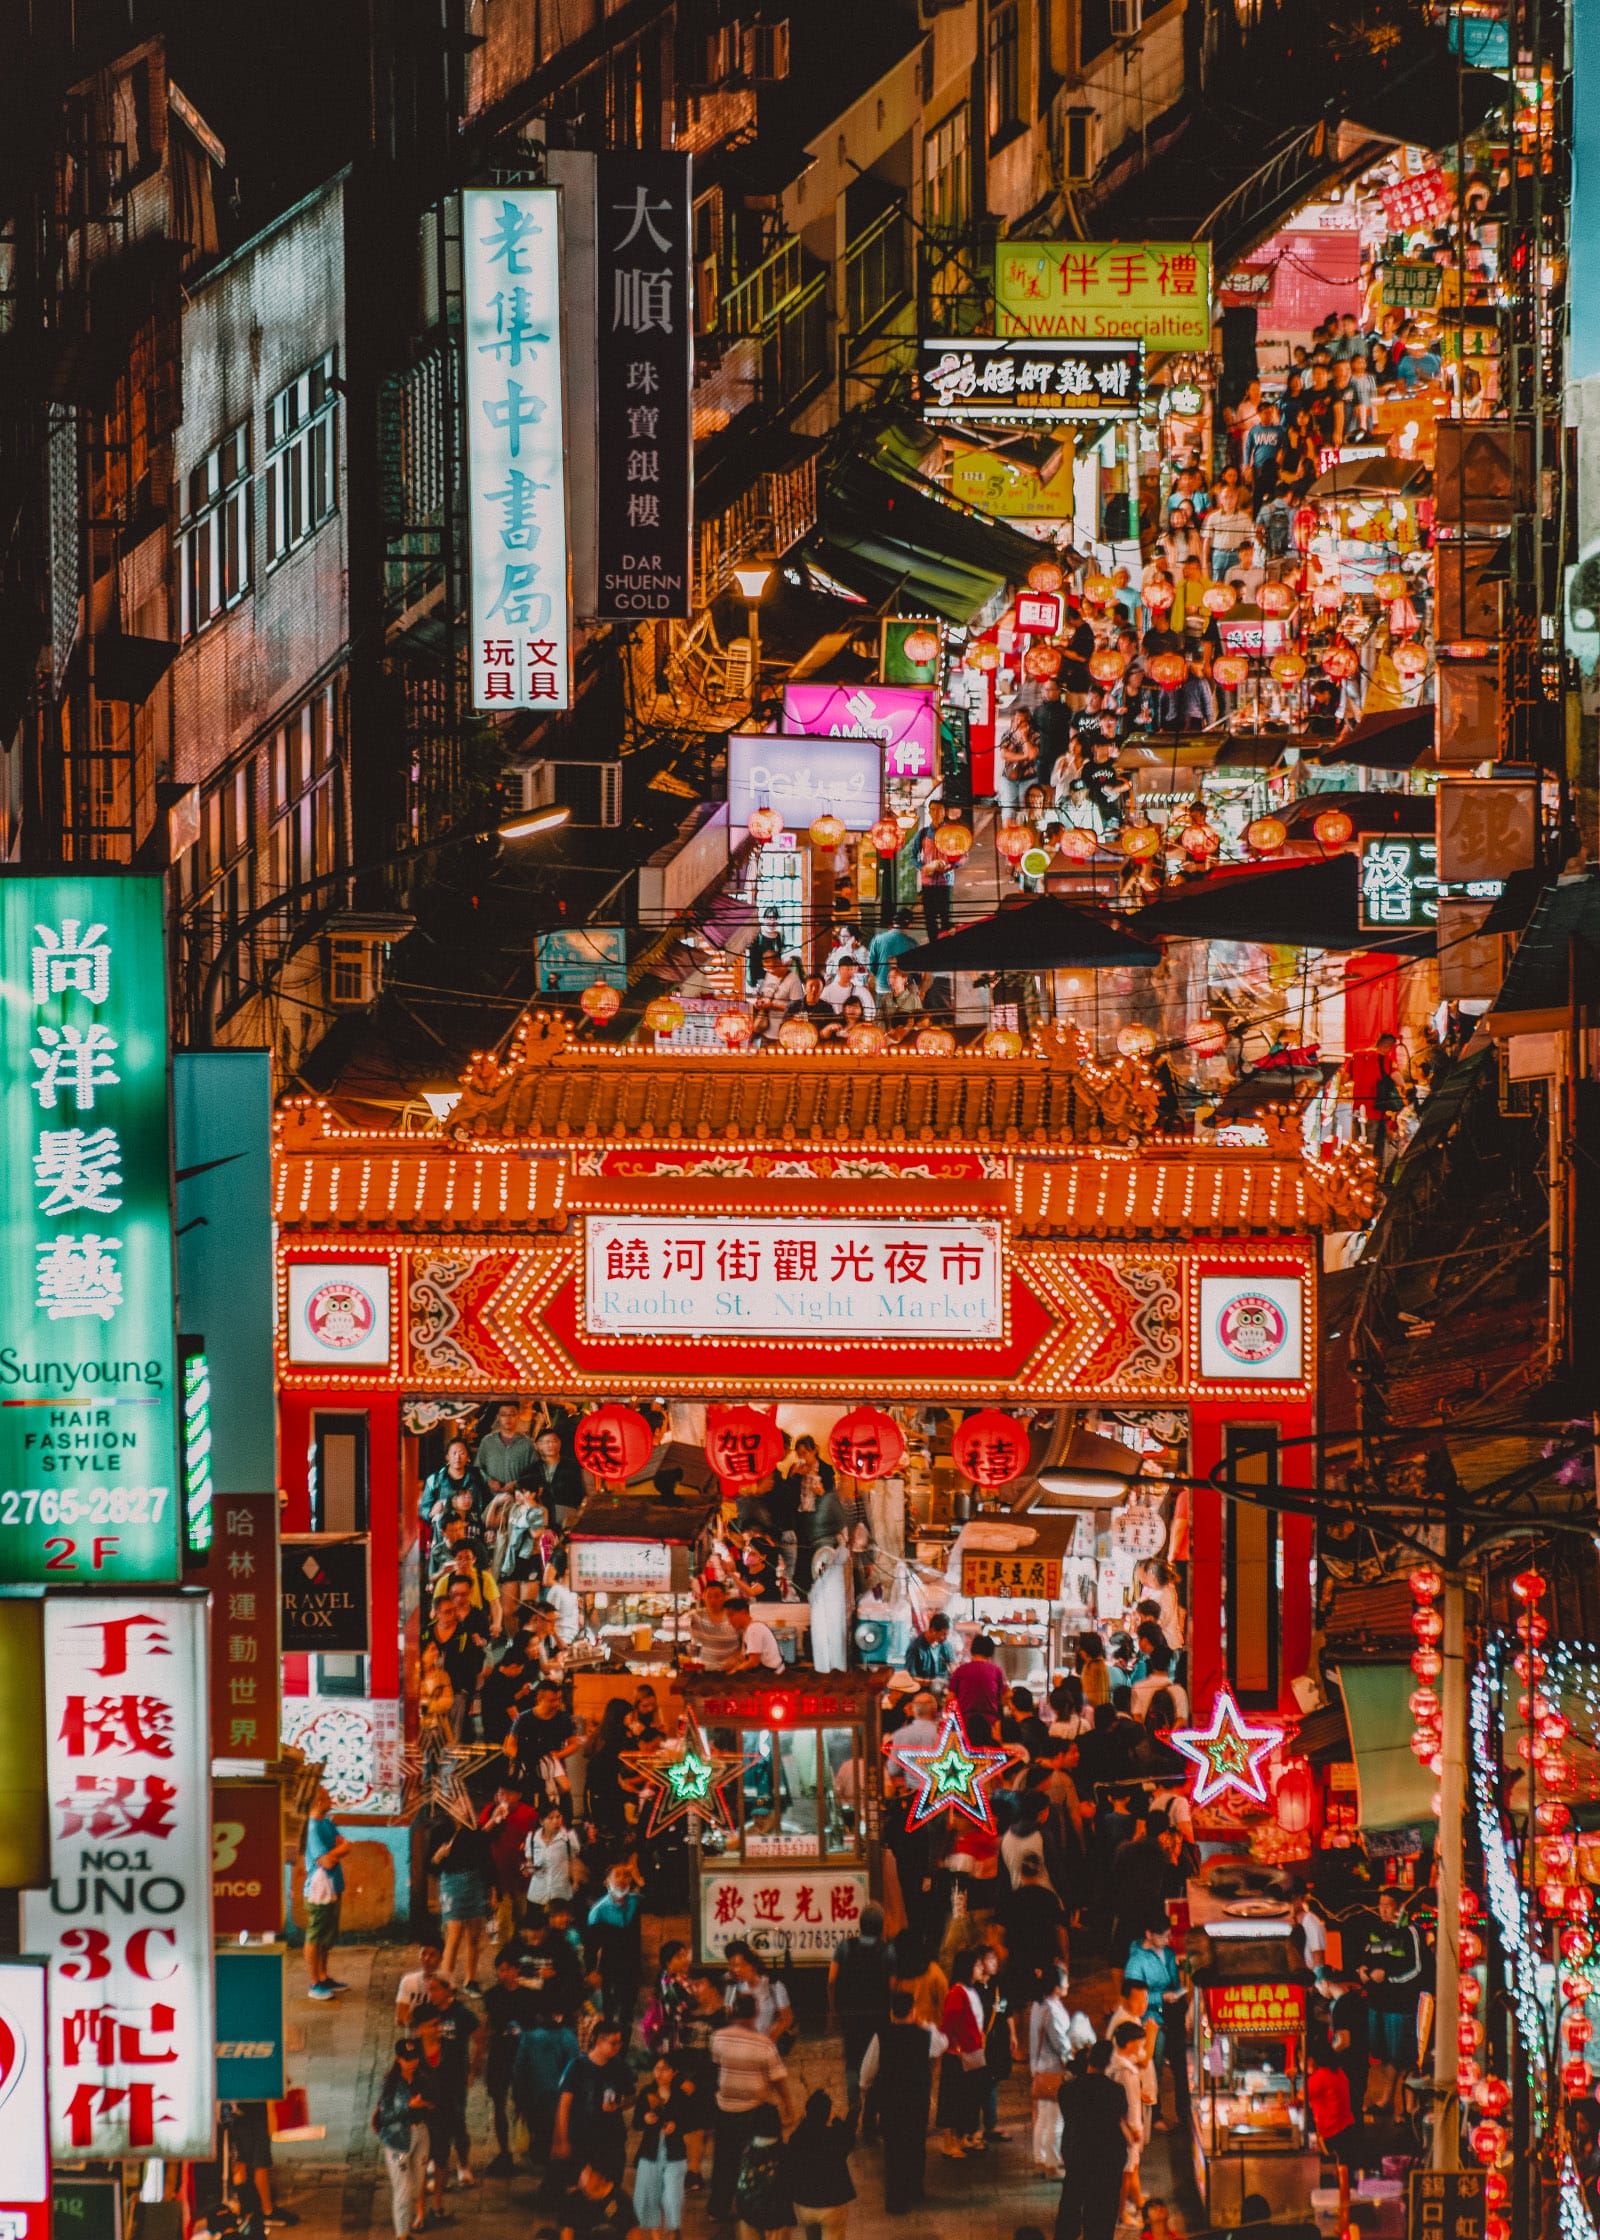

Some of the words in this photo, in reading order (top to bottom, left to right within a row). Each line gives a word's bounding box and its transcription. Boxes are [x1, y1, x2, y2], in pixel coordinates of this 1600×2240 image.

[611, 186, 674, 335] 大順
[1059, 252, 1199, 297] 伴手禮
[1002, 315, 1087, 337] TAIWAN
[1094, 314, 1203, 337] Specialties
[478, 200, 552, 635] 老集中書局
[626, 361, 661, 528] 珠寶銀樓
[605, 574, 682, 590] SHUENN
[622, 554, 662, 571] DAR
[615, 593, 670, 609] GOLD
[483, 638, 516, 700] 玩具
[527, 638, 559, 700] 文具
[30, 919, 123, 1321] 尚洋髮藝
[605, 1238, 984, 1285] 饒河街觀光夜市
[603, 1291, 693, 1316] Raohe
[716, 1292, 750, 1317] St.
[774, 1293, 852, 1320] Night
[879, 1294, 989, 1319] Market
[0, 1348, 163, 1392] Sunyoung
[51, 1411, 110, 1427] HAIR
[25, 1433, 136, 1450] FASHION
[717, 1431, 760, 1476] 賀
[831, 1436, 880, 1473] 新
[965, 1440, 1014, 1481] 禧
[42, 1454, 121, 1471] STYLE
[1, 1486, 169, 1525] 2765-2827
[44, 1536, 120, 1570] 2F
[226, 1509, 257, 1746] 哈林運動世界
[57, 1614, 177, 1840] 手機殼
[79, 1850, 152, 1872] NO.1
[50, 1877, 185, 1916] UNO
[714, 1885, 860, 1926] 歡迎光臨
[59, 1927, 178, 1982] 3C
[62, 2003, 180, 2148] 配件
